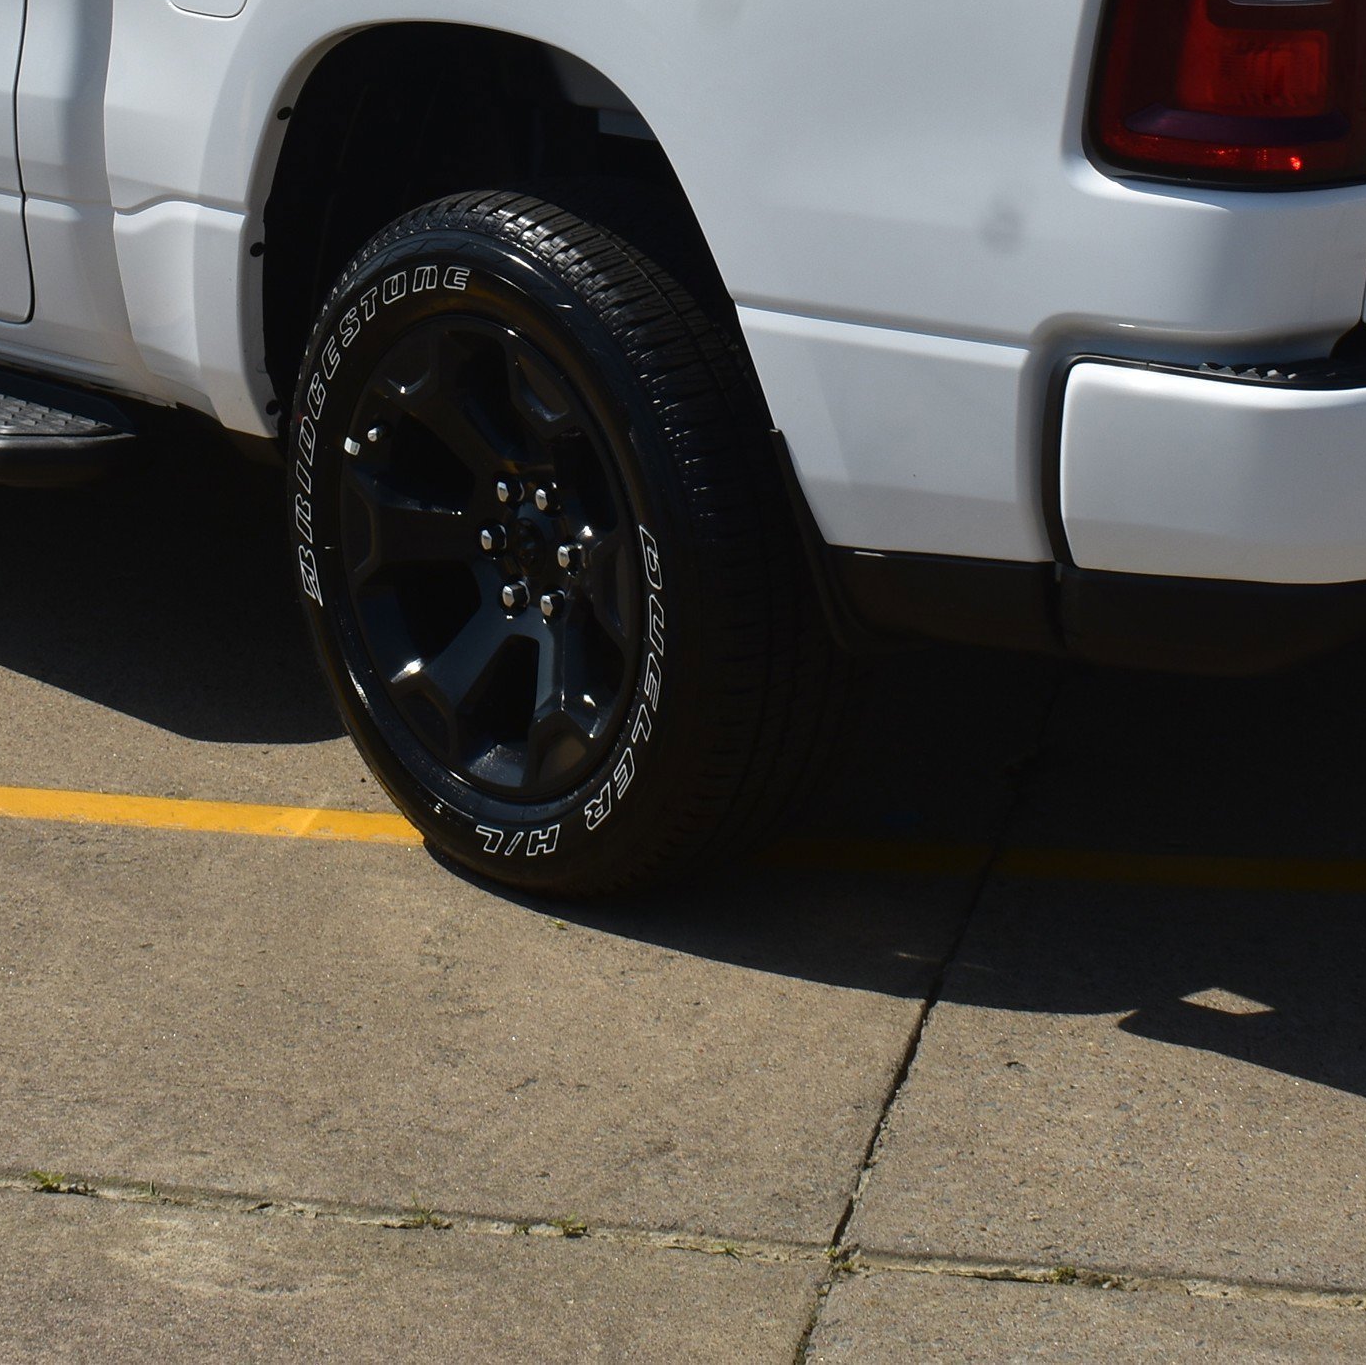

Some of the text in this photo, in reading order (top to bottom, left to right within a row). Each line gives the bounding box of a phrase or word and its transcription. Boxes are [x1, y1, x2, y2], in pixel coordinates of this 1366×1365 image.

[294, 265, 471, 607] BRIDGESTONE
[475, 524, 664, 856] DUELER H/L
